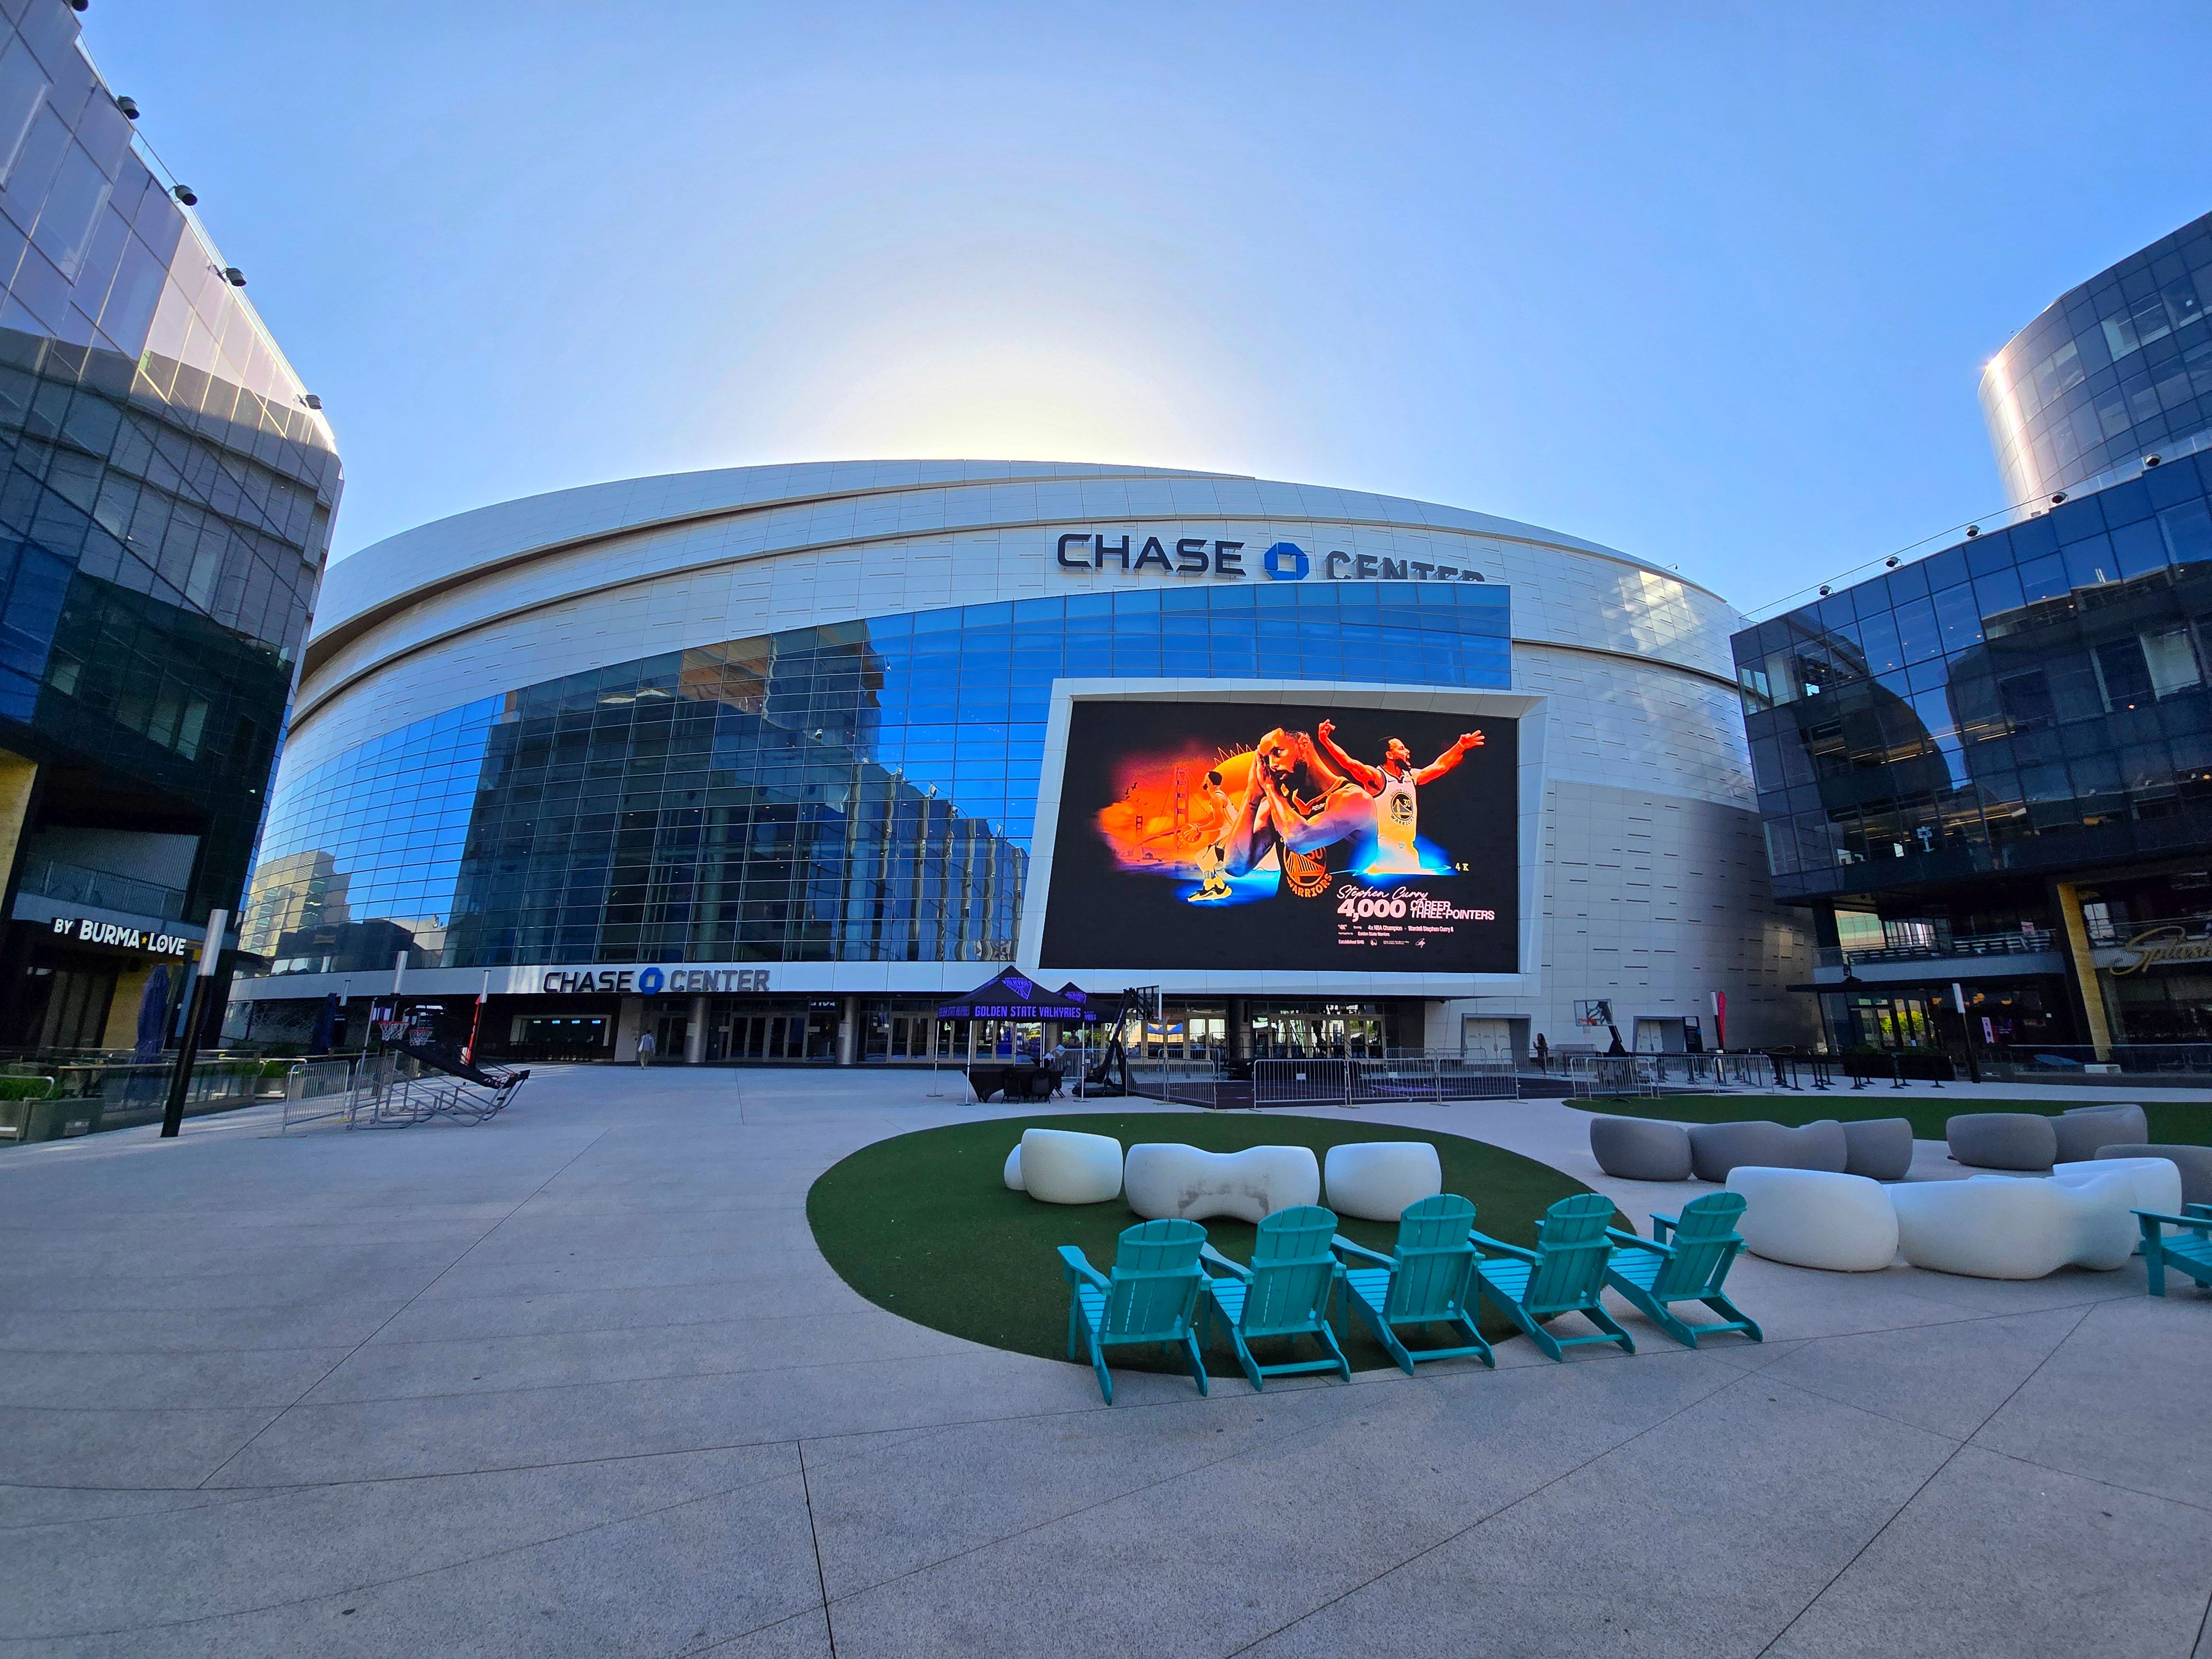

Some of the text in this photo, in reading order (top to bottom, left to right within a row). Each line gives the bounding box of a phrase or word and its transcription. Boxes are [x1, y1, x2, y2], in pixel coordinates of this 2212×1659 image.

[1057, 533, 1246, 577] CHASE
[1403, 799, 1411, 807] 30
[1286, 873, 1332, 898] WARRIORS
[1337, 885, 1428, 903] Stephen Curry
[1337, 899, 1406, 922] 4,000
[1410, 900, 1451, 911] CAREER
[1410, 909, 1495, 921] THREE-POINTERS
[54, 918, 186, 956] BY BURMA LOVE
[543, 969, 770, 993] CHASE CENTER
[975, 1006, 1007, 1017] GOLDEN
[1010, 1006, 1036, 1018] STATE
[1039, 1006, 1081, 1018] VALKYRIES
